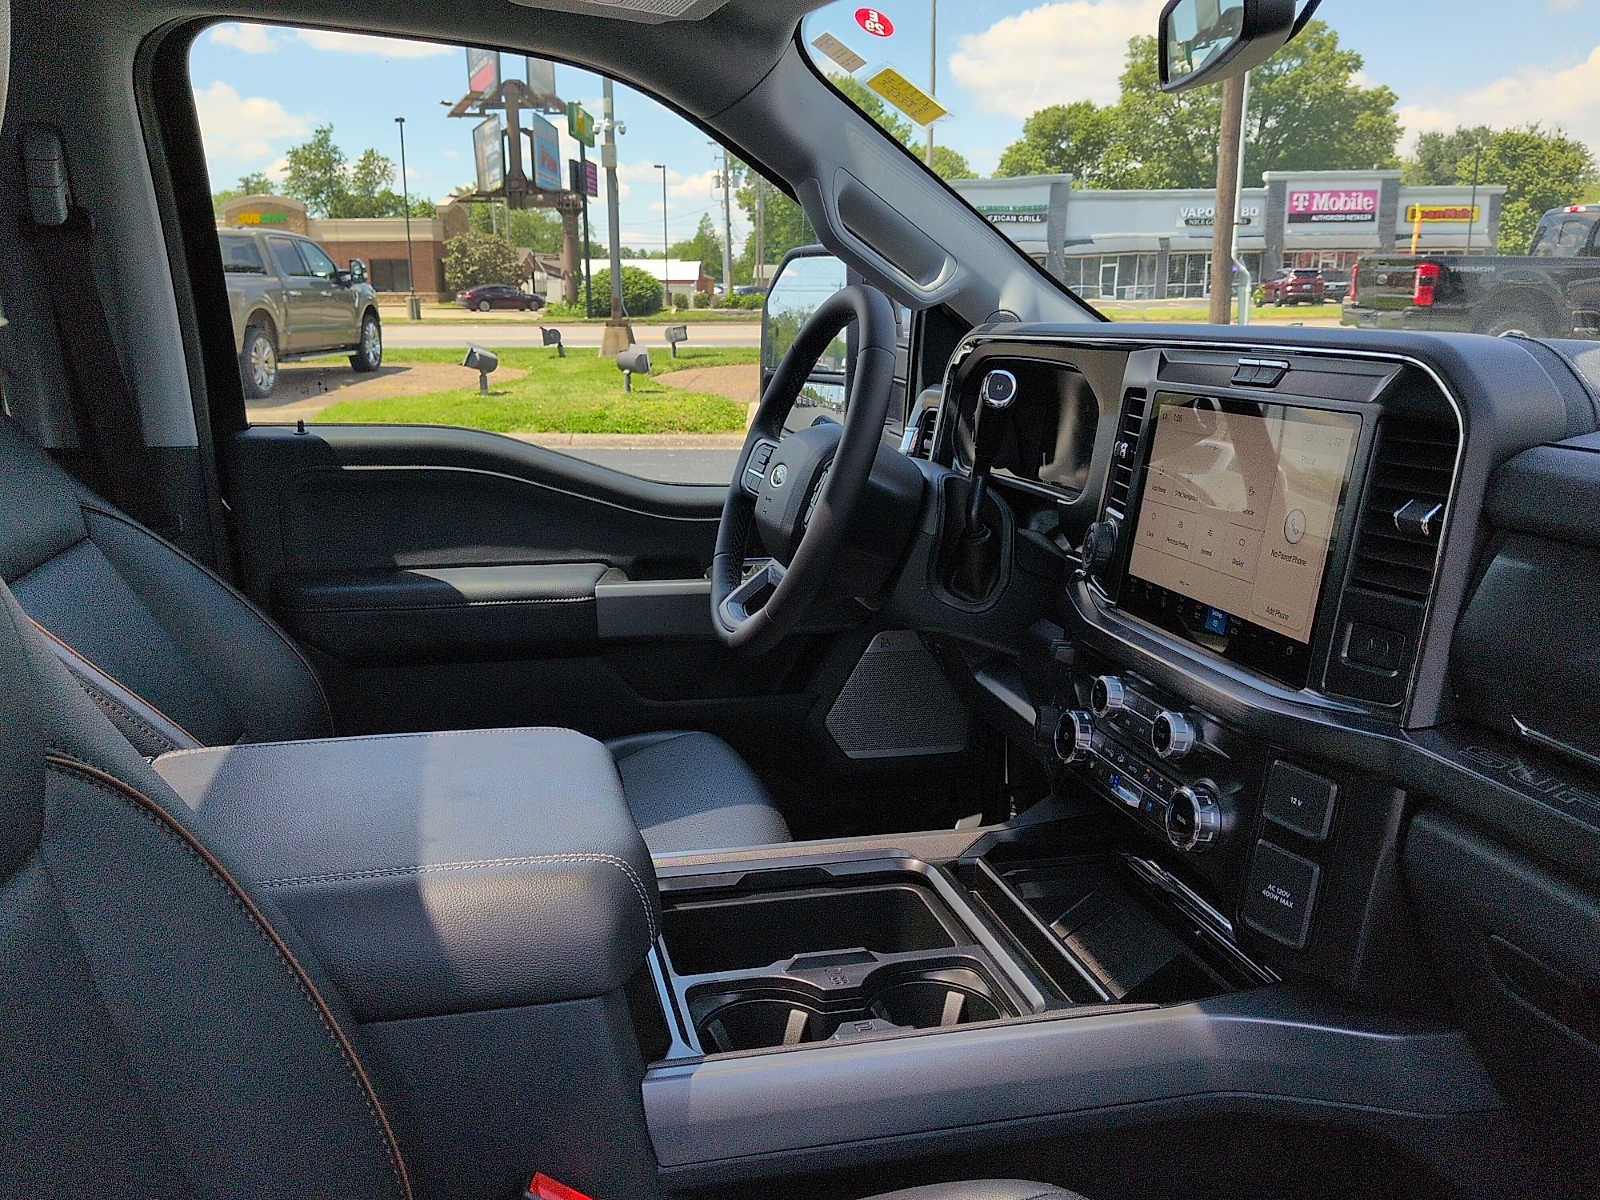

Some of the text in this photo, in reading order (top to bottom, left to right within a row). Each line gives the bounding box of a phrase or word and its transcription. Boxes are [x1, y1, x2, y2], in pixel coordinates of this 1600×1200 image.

[1312, 192, 1374, 211] Mobile
[1181, 207, 1216, 217] VAPO
[988, 214, 1041, 223] EXICAN GRILL
[1449, 265, 1496, 274] TREMOR
[1267, 884, 1291, 899] AC 120V
[1279, 897, 1294, 909] MAX
